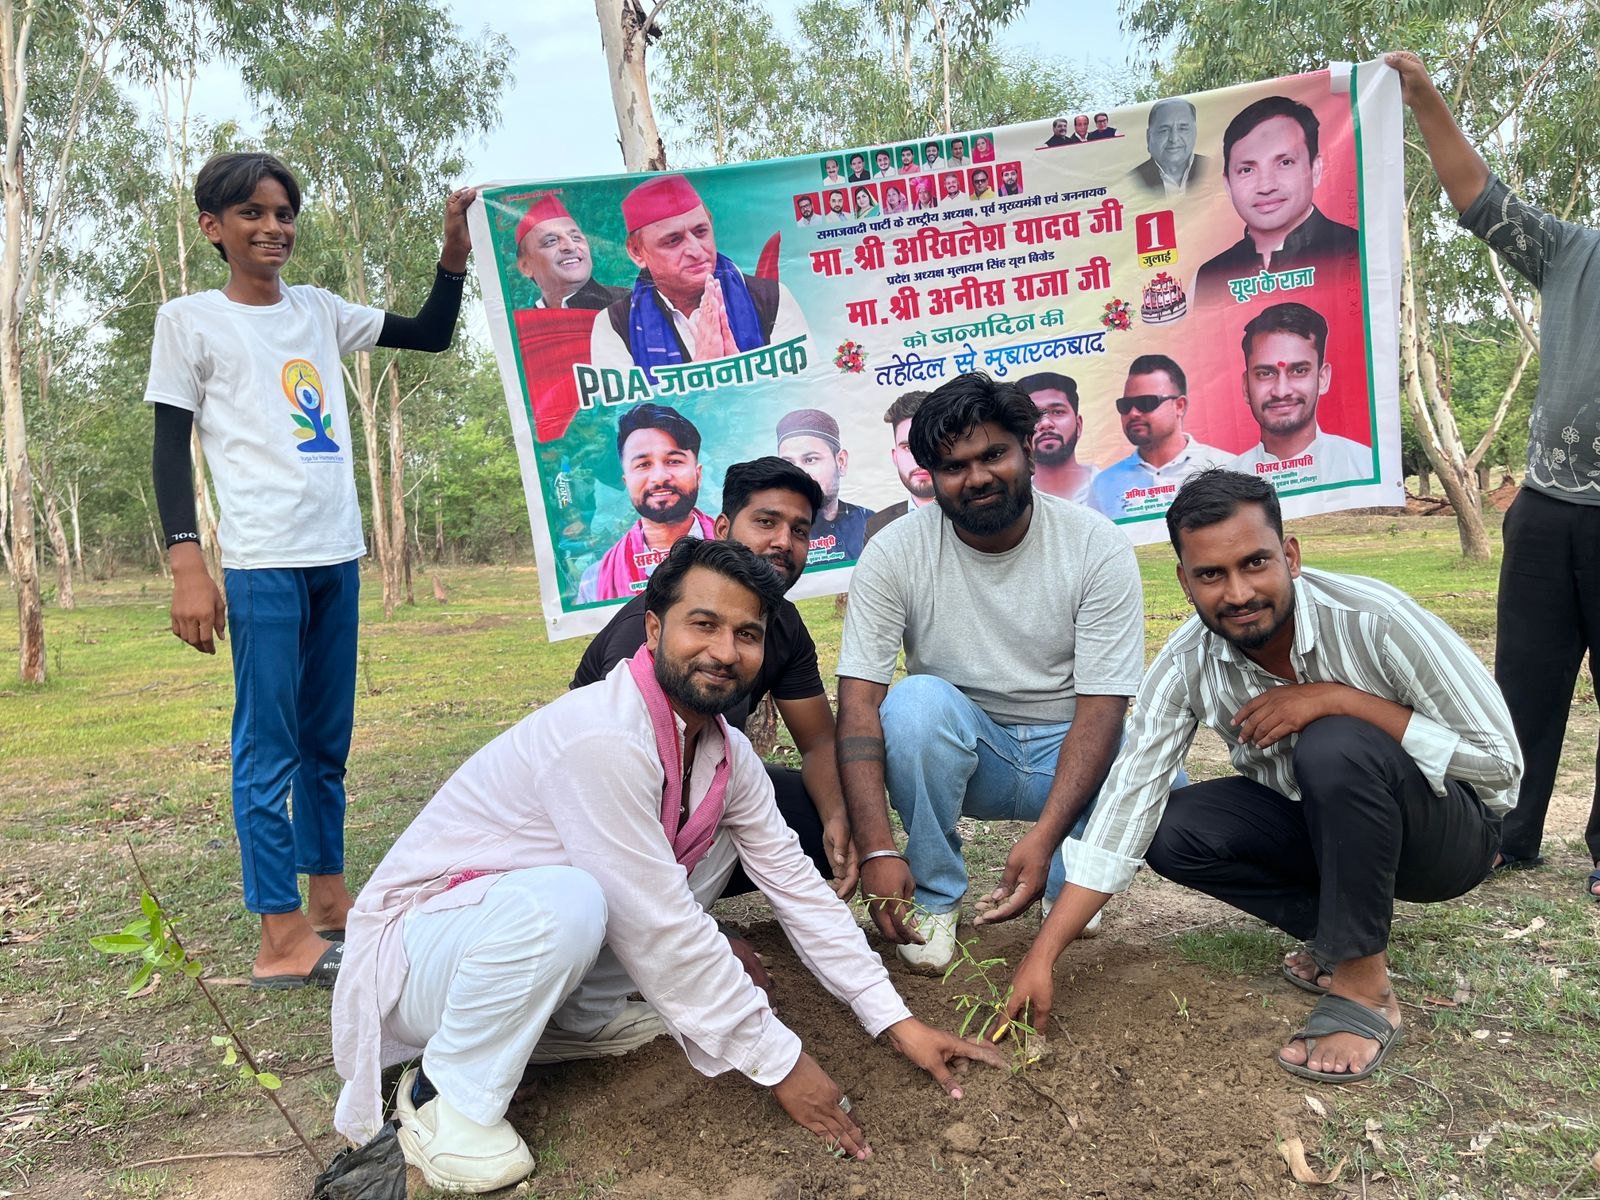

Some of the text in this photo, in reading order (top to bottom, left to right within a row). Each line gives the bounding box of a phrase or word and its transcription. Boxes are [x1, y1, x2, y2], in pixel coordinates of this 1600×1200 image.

[816, 222, 867, 240] समाजवादी
[870, 218, 891, 232] पार्टी
[894, 216, 904, 228] के
[906, 212, 939, 228] राष्ट्रीय
[980, 201, 996, 217] पूर्व
[998, 194, 1042, 213] मुख्यमंत्री
[1044, 192, 1058, 206] एवं
[1061, 186, 1107, 202] जननायक
[893, 220, 1006, 266] अखिलेश
[1013, 211, 1080, 246] यादव
[1087, 198, 1124, 234] जी
[1145, 216, 1164, 250] 1
[886, 272, 911, 286] प्रदेश
[914, 268, 944, 282] अध्यक्ष
[947, 264, 984, 281] मुलायम
[986, 257, 1006, 271] सिंह
[1008, 254, 1026, 269] यूथ
[1142, 251, 1172, 268] जुलाई
[928, 276, 1005, 316] अनीस
[1011, 268, 1070, 303] राजा
[1076, 256, 1112, 292] जी
[1230, 267, 1314, 300] यूथ के राजा
[903, 308, 1064, 349] को जन्मदिन की
[576, 334, 808, 407] PDA जननायक
[875, 331, 1106, 386] तहेदिल से मुबारकबाद
[1256, 454, 1313, 474] विजय प्रजापति
[1126, 488, 1146, 499] अमित
